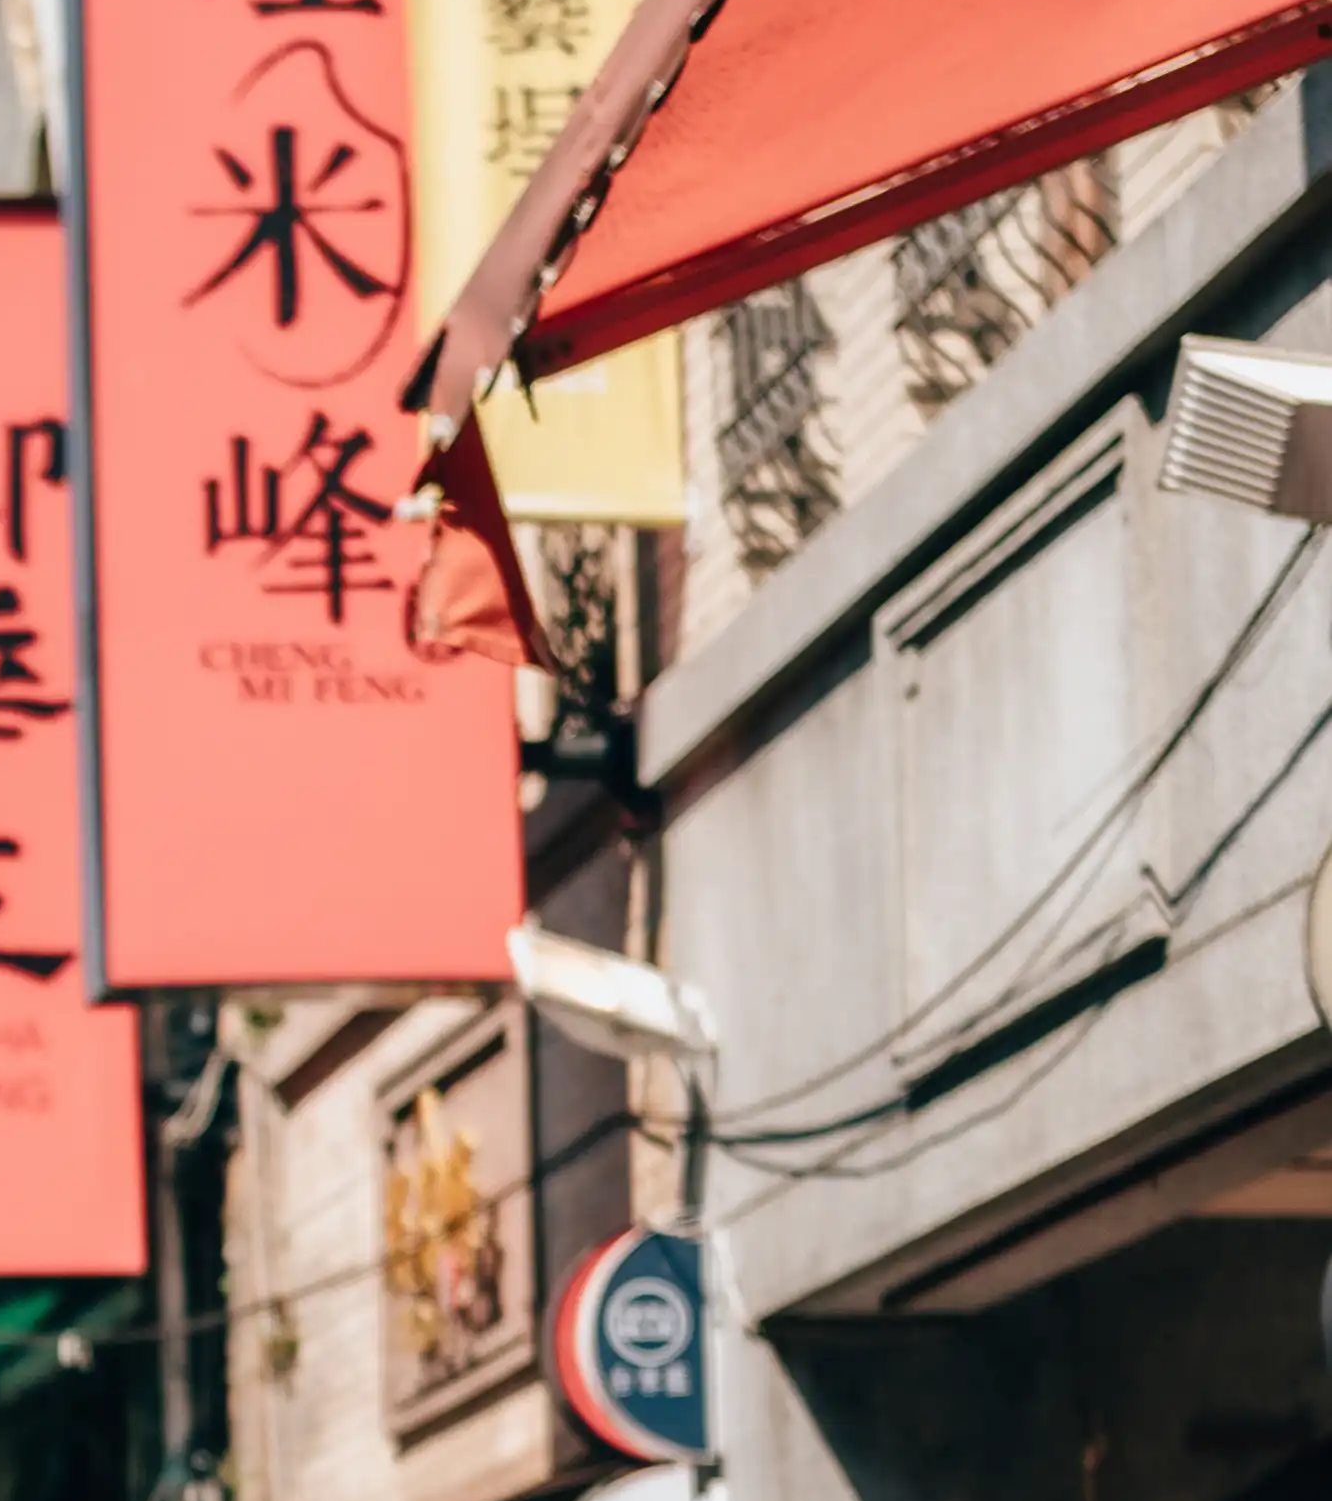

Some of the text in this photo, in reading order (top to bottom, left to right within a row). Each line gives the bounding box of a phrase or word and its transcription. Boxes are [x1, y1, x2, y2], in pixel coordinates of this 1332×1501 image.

[198, 641, 353, 672] CHENG
[240, 674, 426, 704] MI FENG
